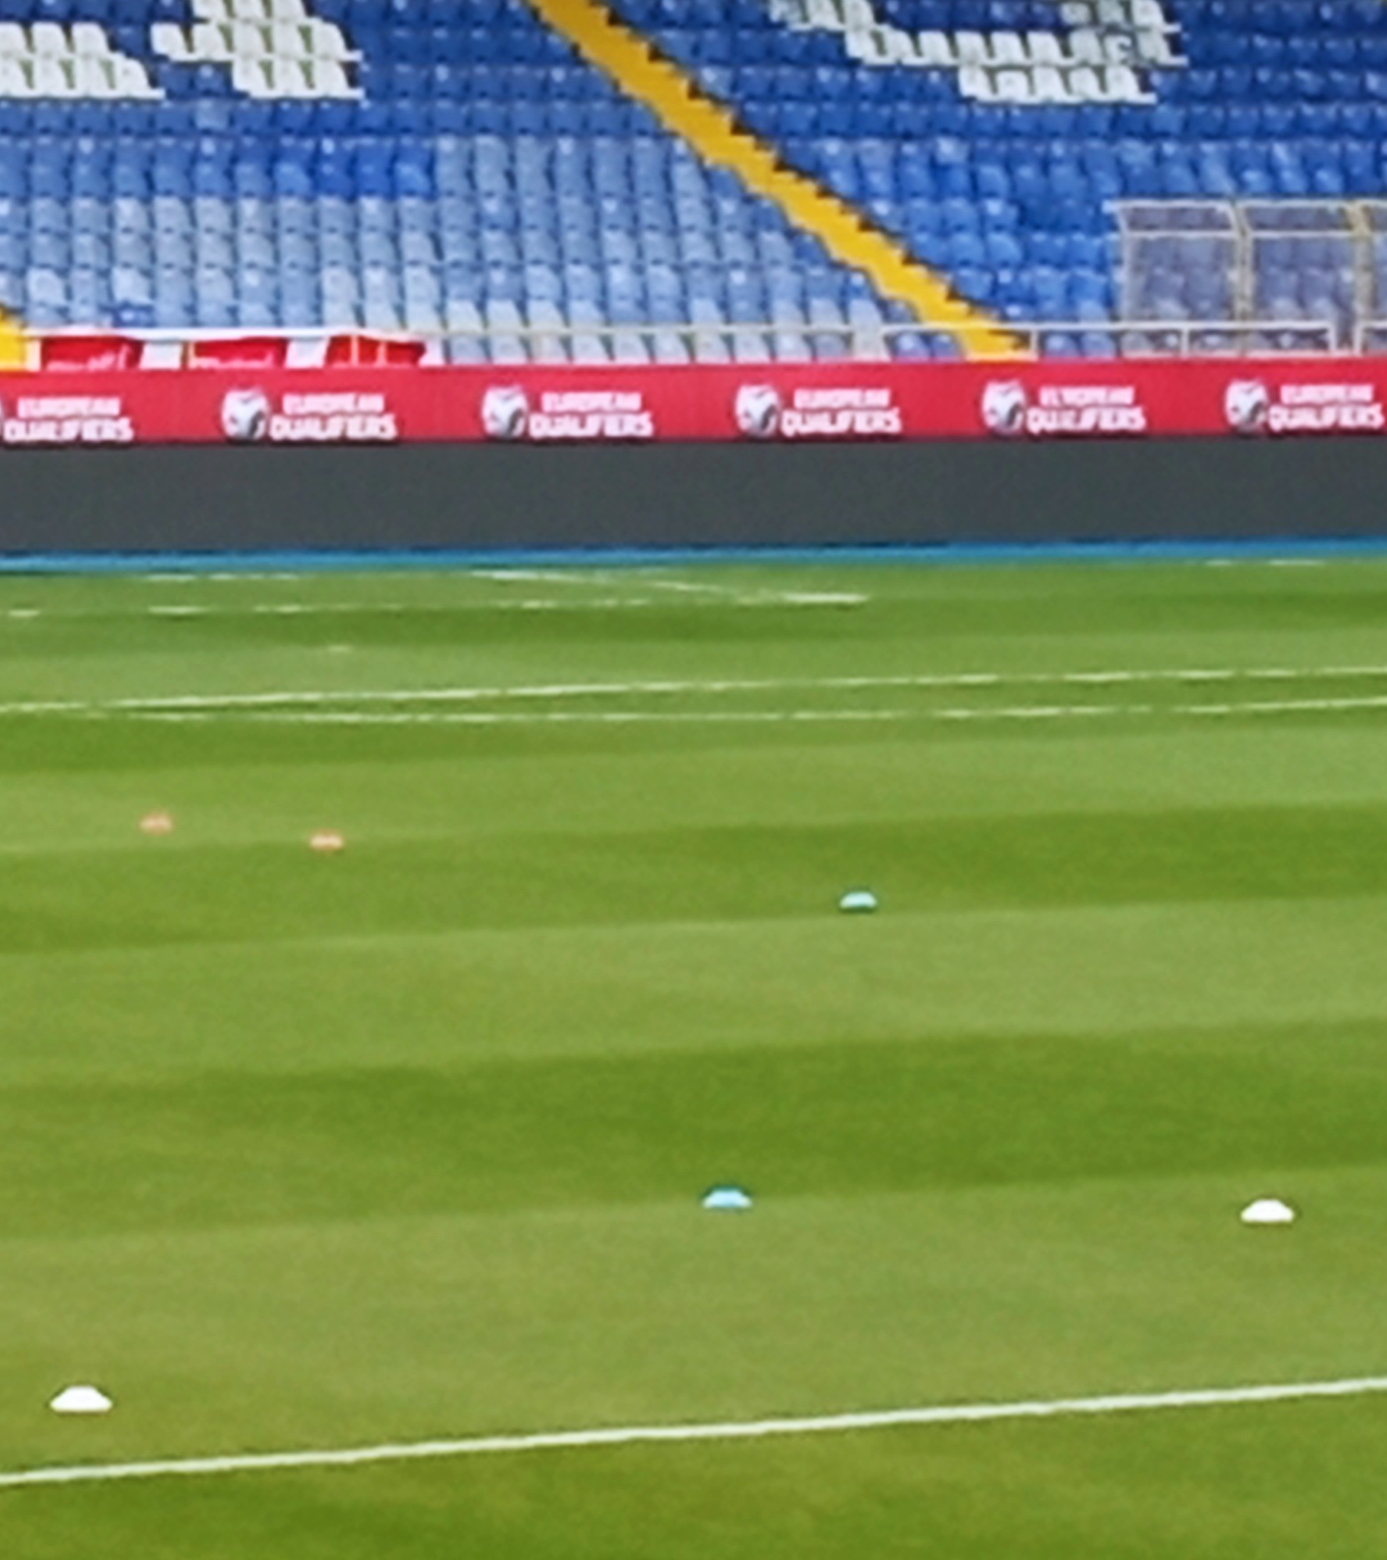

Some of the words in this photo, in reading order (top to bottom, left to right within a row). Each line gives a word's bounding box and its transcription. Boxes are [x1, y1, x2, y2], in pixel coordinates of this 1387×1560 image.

[17, 397, 120, 418] EUROPEAN
[282, 393, 384, 414] EUROPEAN
[541, 391, 642, 412] EUROPEAN
[3, 417, 133, 441] QUALIFIERS
[269, 413, 398, 440] QUALIFIERS
[529, 411, 654, 439] QUALIFIERS
[780, 407, 902, 437] QUALIFIERS
